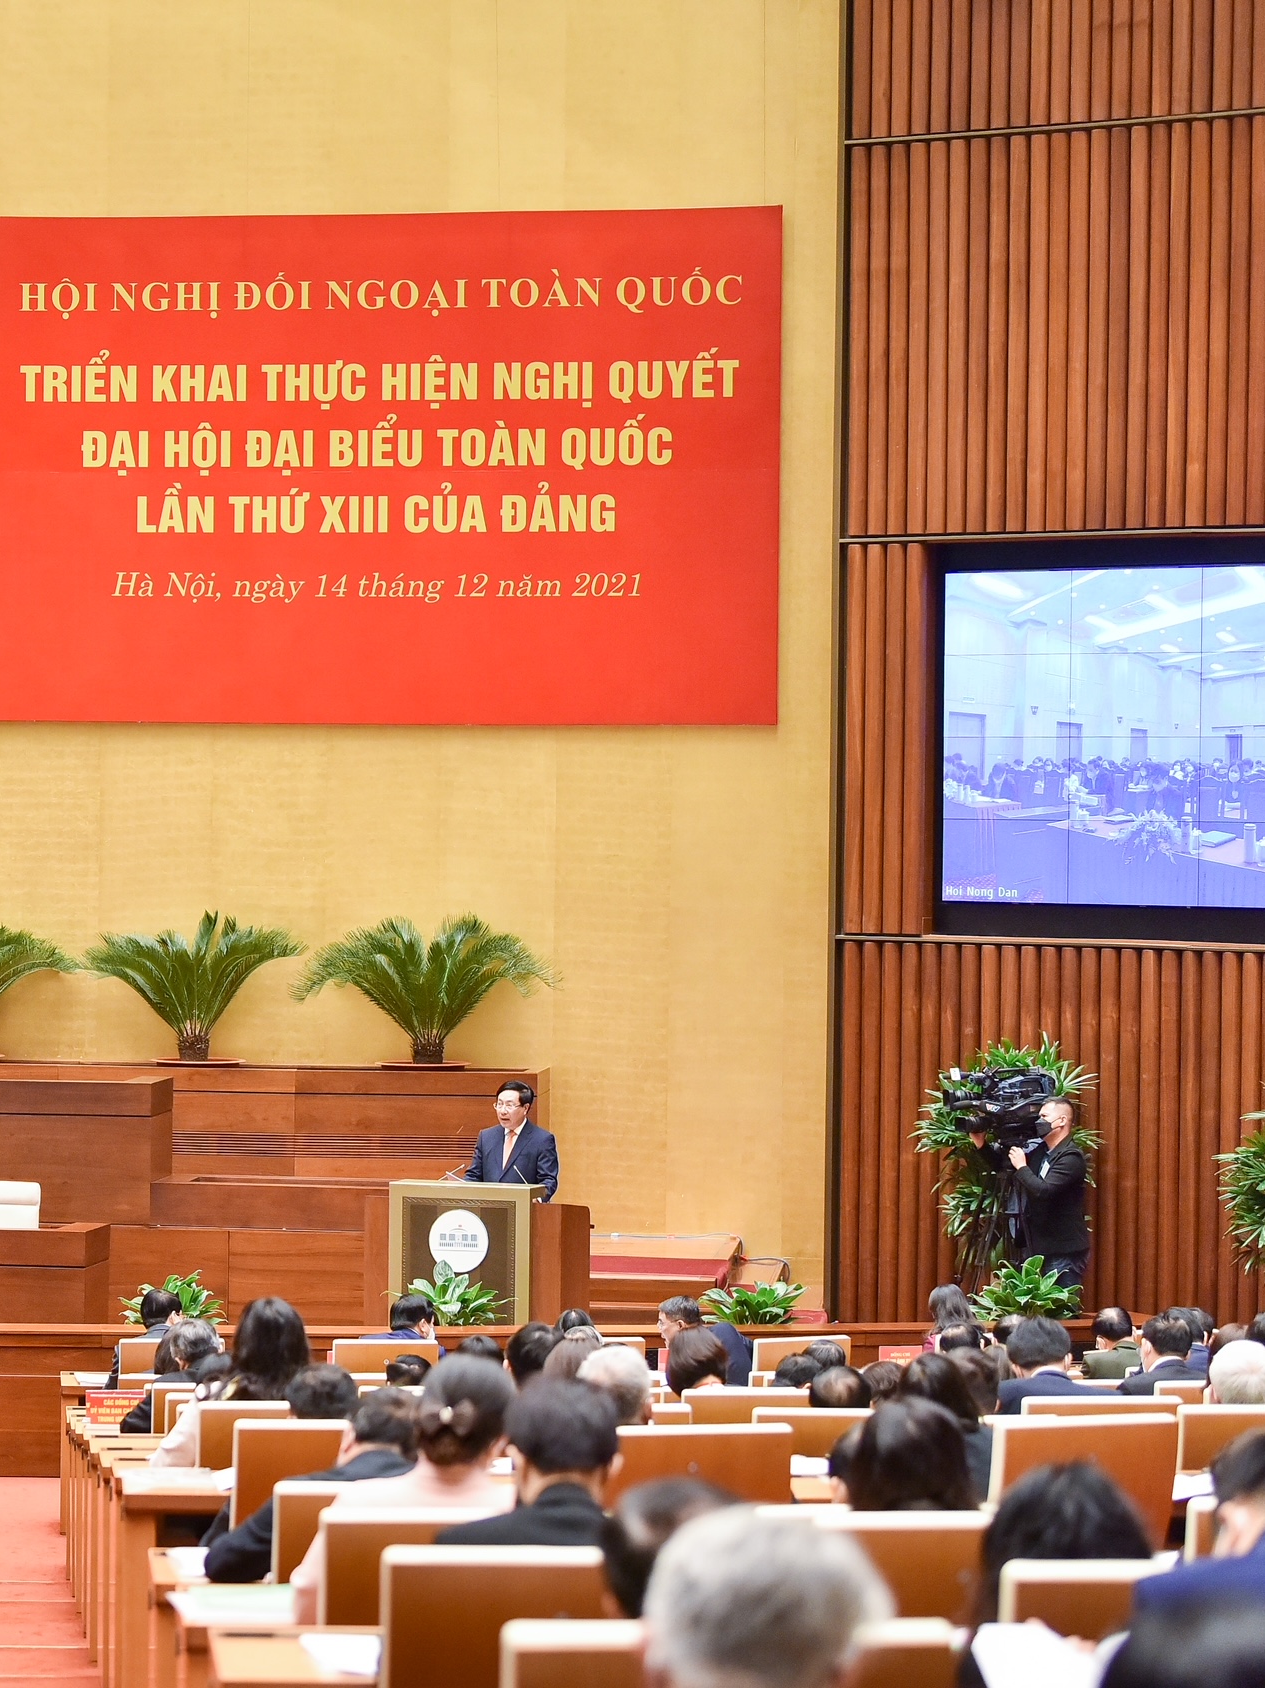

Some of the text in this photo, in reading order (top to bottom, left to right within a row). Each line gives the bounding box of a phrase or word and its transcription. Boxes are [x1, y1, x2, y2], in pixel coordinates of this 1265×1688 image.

[20, 267, 742, 319] HỘI NGHỊ ĐỐI NGOẠI TOÀN QUỐC
[20, 348, 739, 410] TRIỂN KHAI THỰC HIỆN NGHỊ QUYẾT
[81, 414, 672, 476] ĐẠI HỘI ĐẠI BIỂU TOÀN QUỐC
[137, 482, 615, 533] LẦN THỨ XIII CỦA ĐẢNG
[112, 571, 641, 604] Hà Nội, ngày 14 tháng 12 năm 2021
[945, 885, 1018, 900] Hoi Nong Dan
